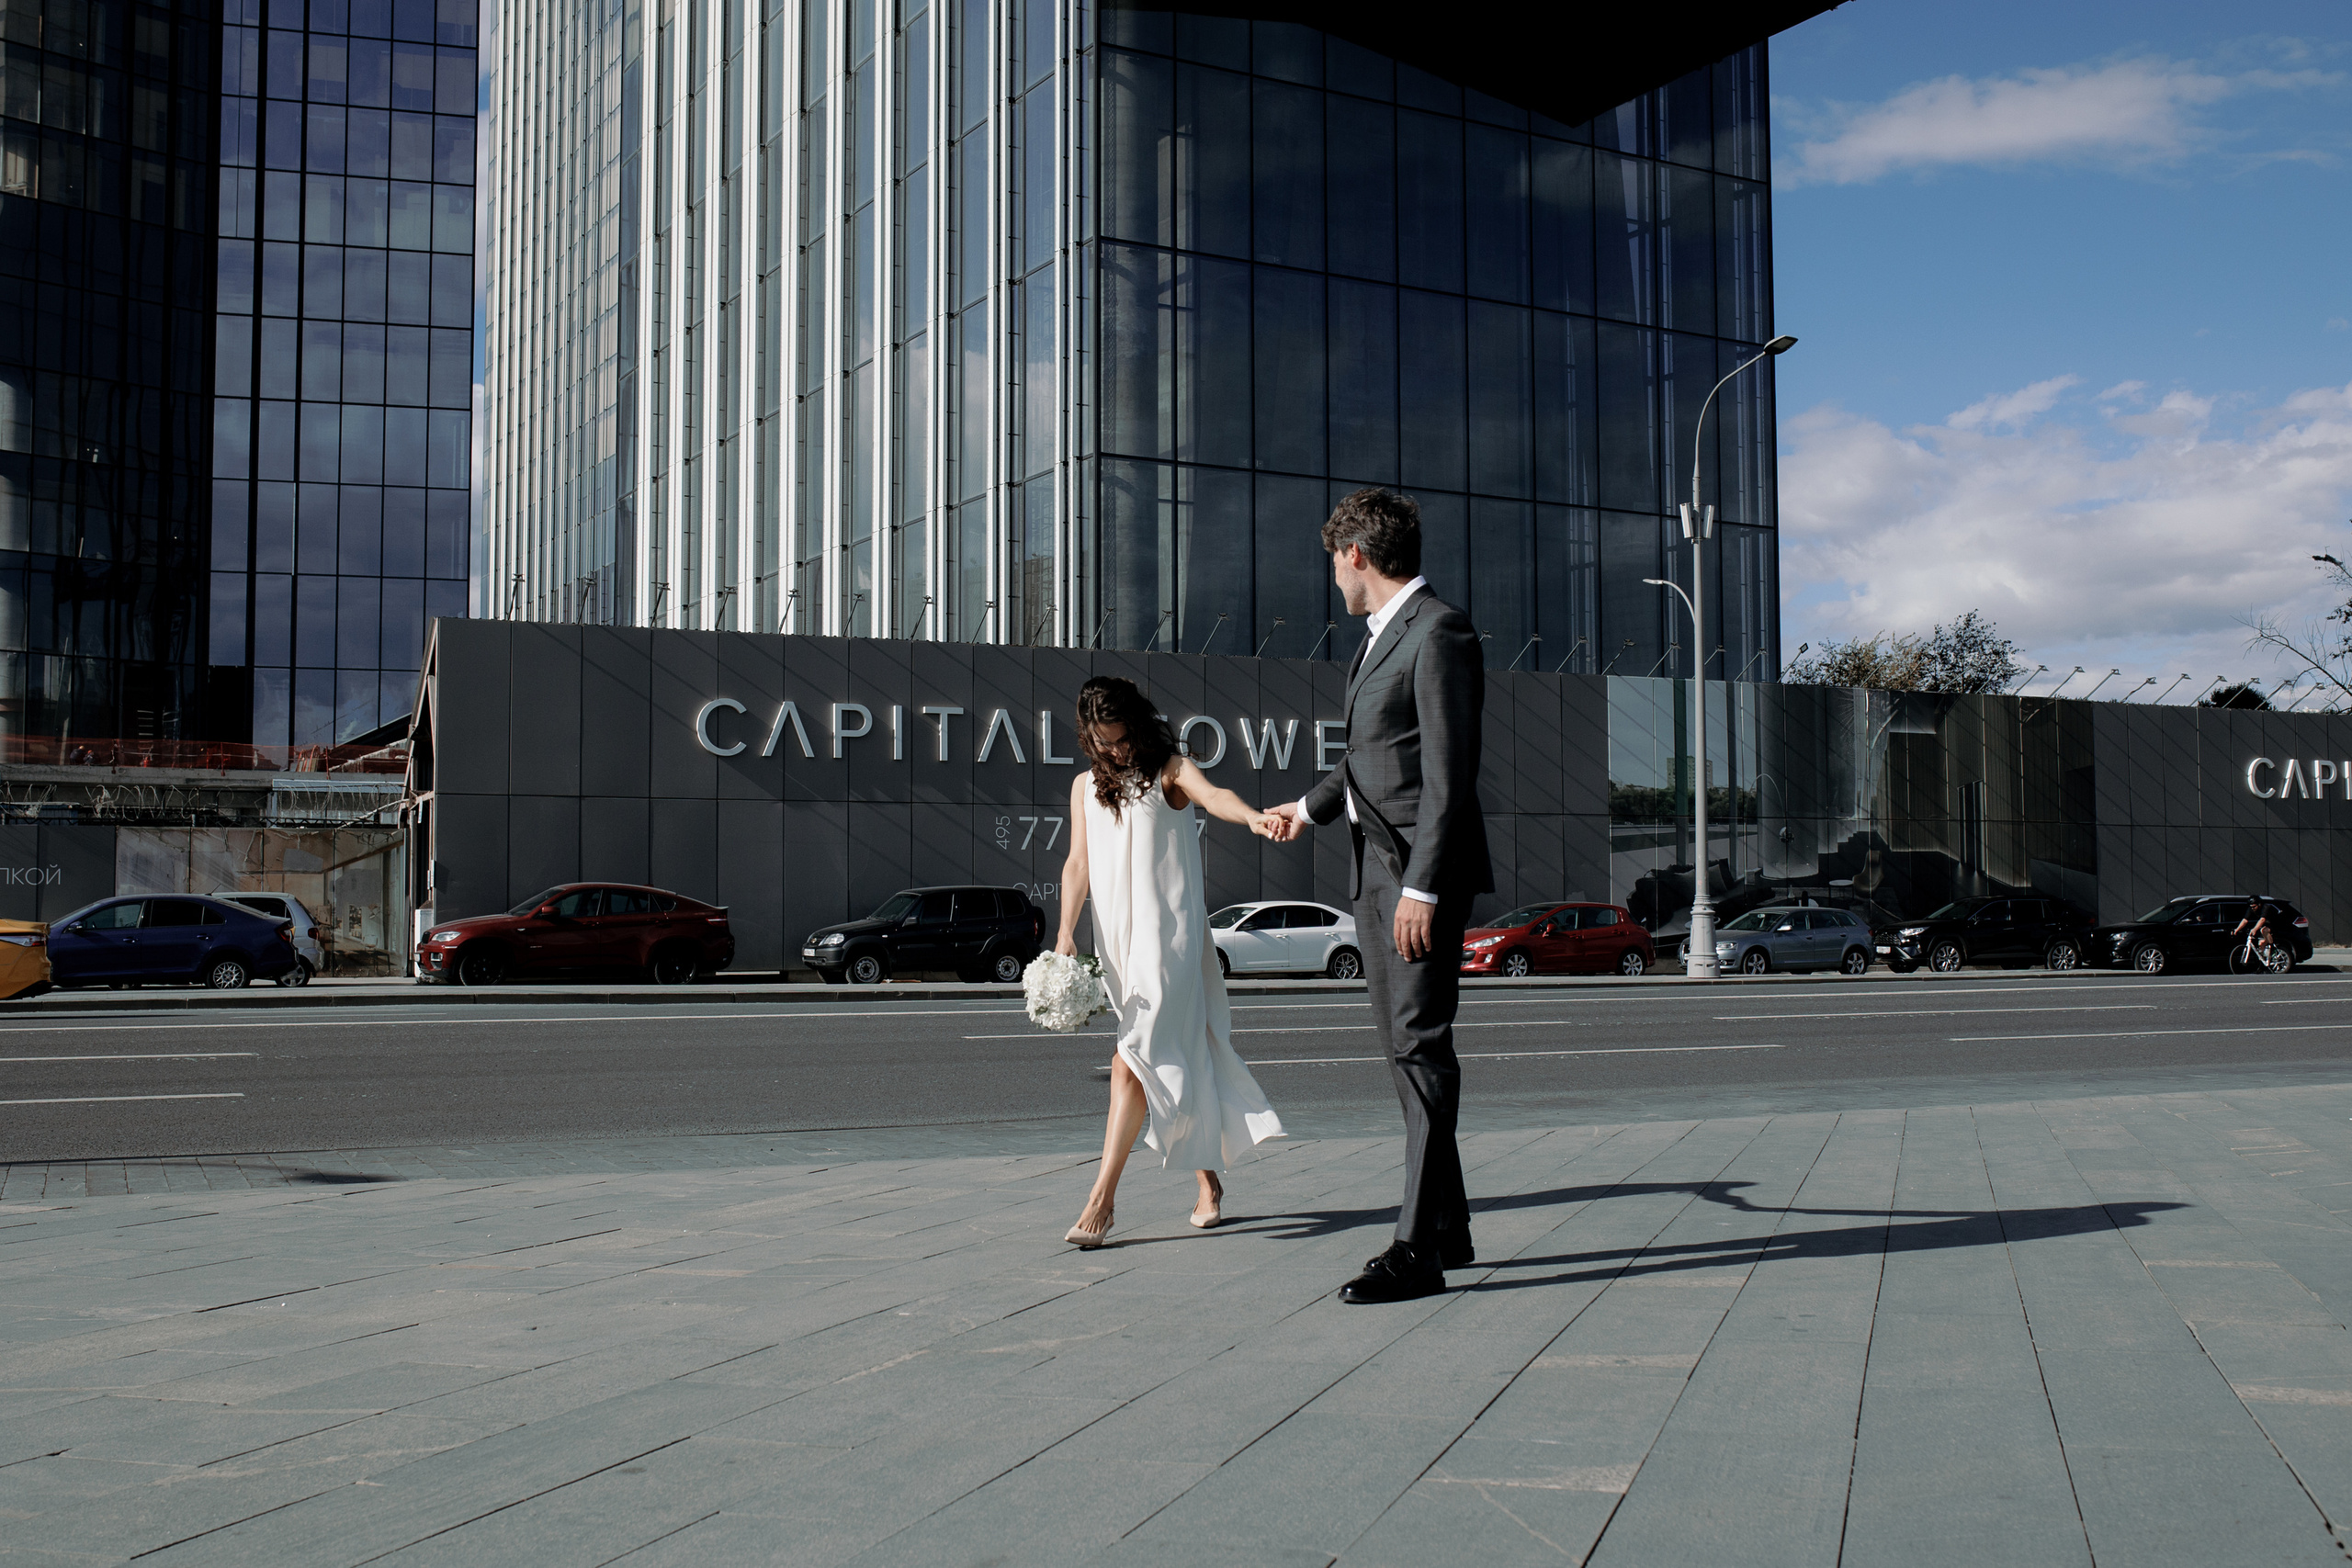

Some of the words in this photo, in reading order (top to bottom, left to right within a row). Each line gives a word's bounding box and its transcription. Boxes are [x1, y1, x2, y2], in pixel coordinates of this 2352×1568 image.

[695, 697, 1074, 765] CAPITAL
[1154, 715, 1348, 772] OWE
[2247, 757, 2352, 800] CAPI
[995, 815, 1011, 851] 495
